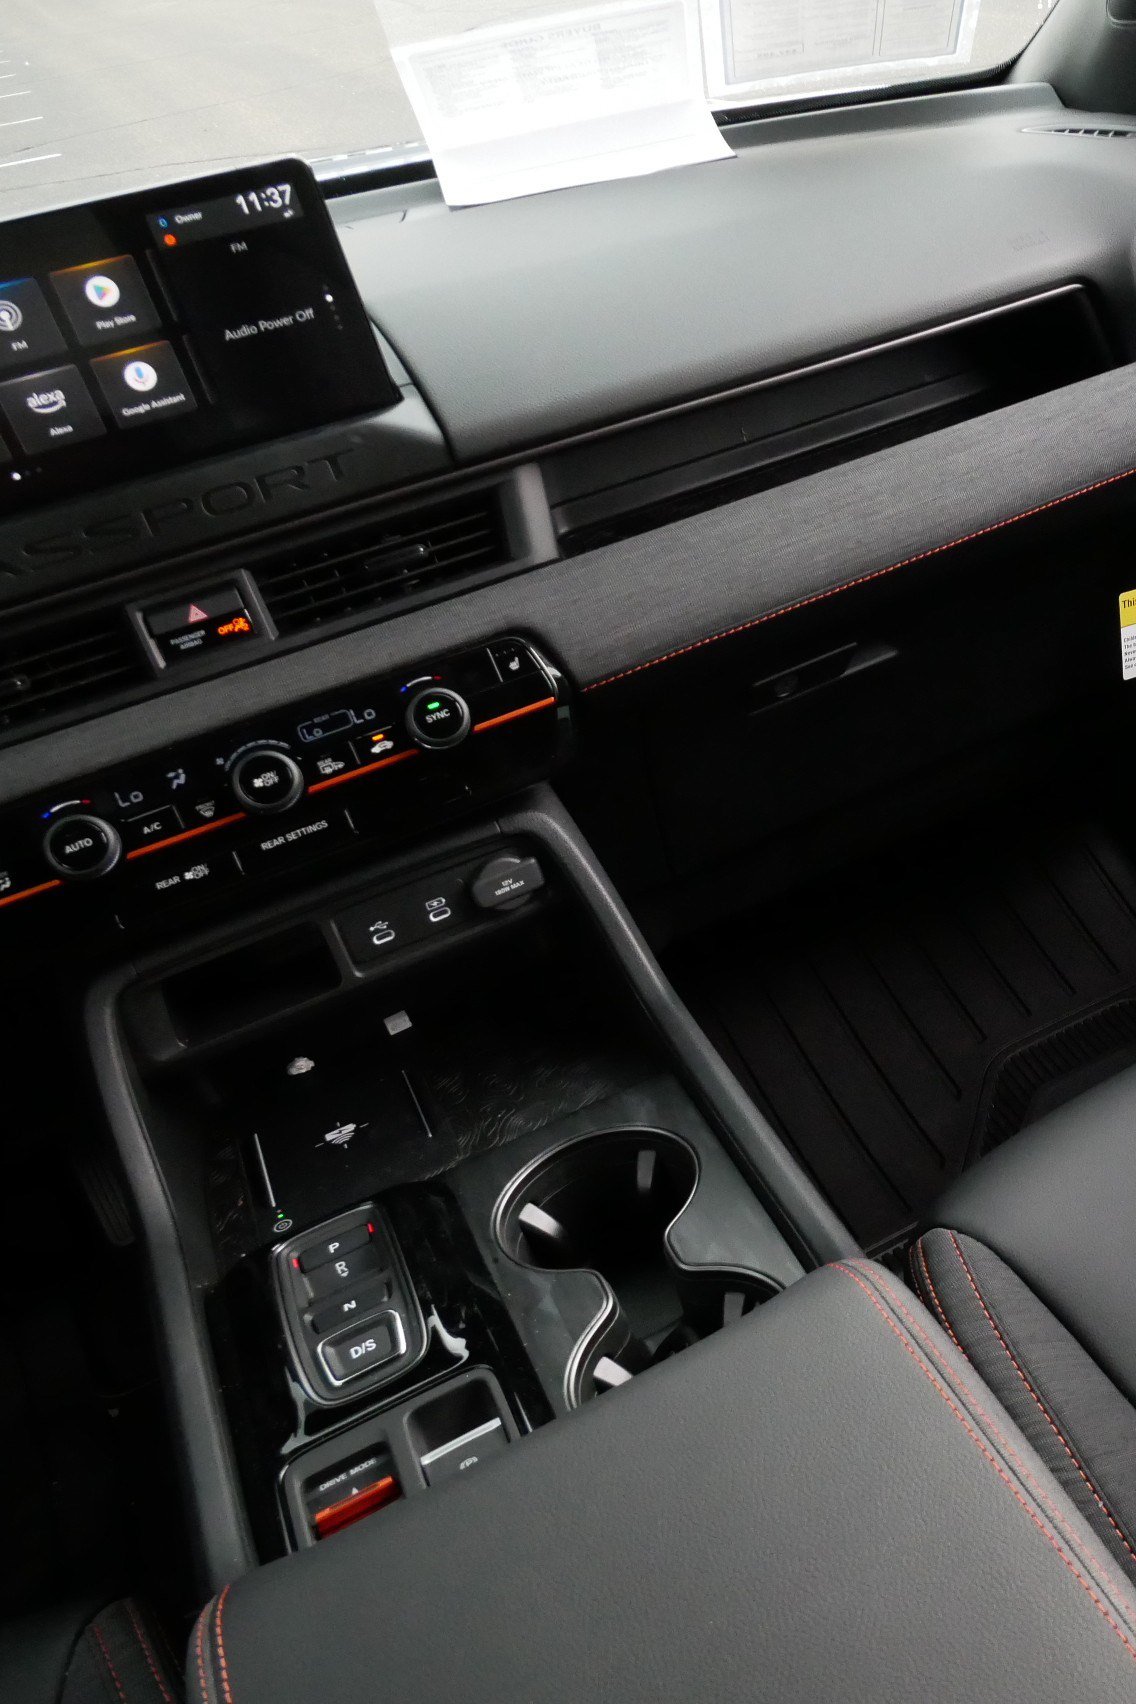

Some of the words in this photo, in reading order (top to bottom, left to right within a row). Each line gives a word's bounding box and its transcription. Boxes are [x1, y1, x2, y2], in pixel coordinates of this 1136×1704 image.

[236, 184, 292, 215] 11:37
[174, 212, 203, 224] Owner
[230, 241, 249, 254] FM
[96, 318, 115, 330] Play
[114, 314, 137, 325] Store
[224, 324, 258, 341] Audio
[258, 315, 294, 332] Power
[295, 307, 315, 322] Off
[11, 340, 29, 351] FM
[26, 389, 66, 408] alexa
[121, 403, 151, 417] Google
[151, 393, 186, 409] Assistant
[50, 424, 74, 437] Alexa
[217, 623, 234, 636] OFF
[425, 708, 451, 724] SYNC
[262, 775, 279, 787] OFF
[143, 821, 163, 835] A/C
[260, 836, 286, 851] REAR
[285, 820, 329, 842] SETTINGS
[64, 837, 94, 855] AUTO
[194, 868, 210, 880] OFF
[155, 875, 181, 890] REAR
[510, 880, 525, 890] MAX
[328, 1242, 340, 1254] P
[335, 1261, 347, 1275] R
[343, 1300, 357, 1312] N
[349, 1338, 377, 1360] D/S
[319, 1473, 348, 1492] DRIVE
[350, 1458, 377, 1475] MODE
